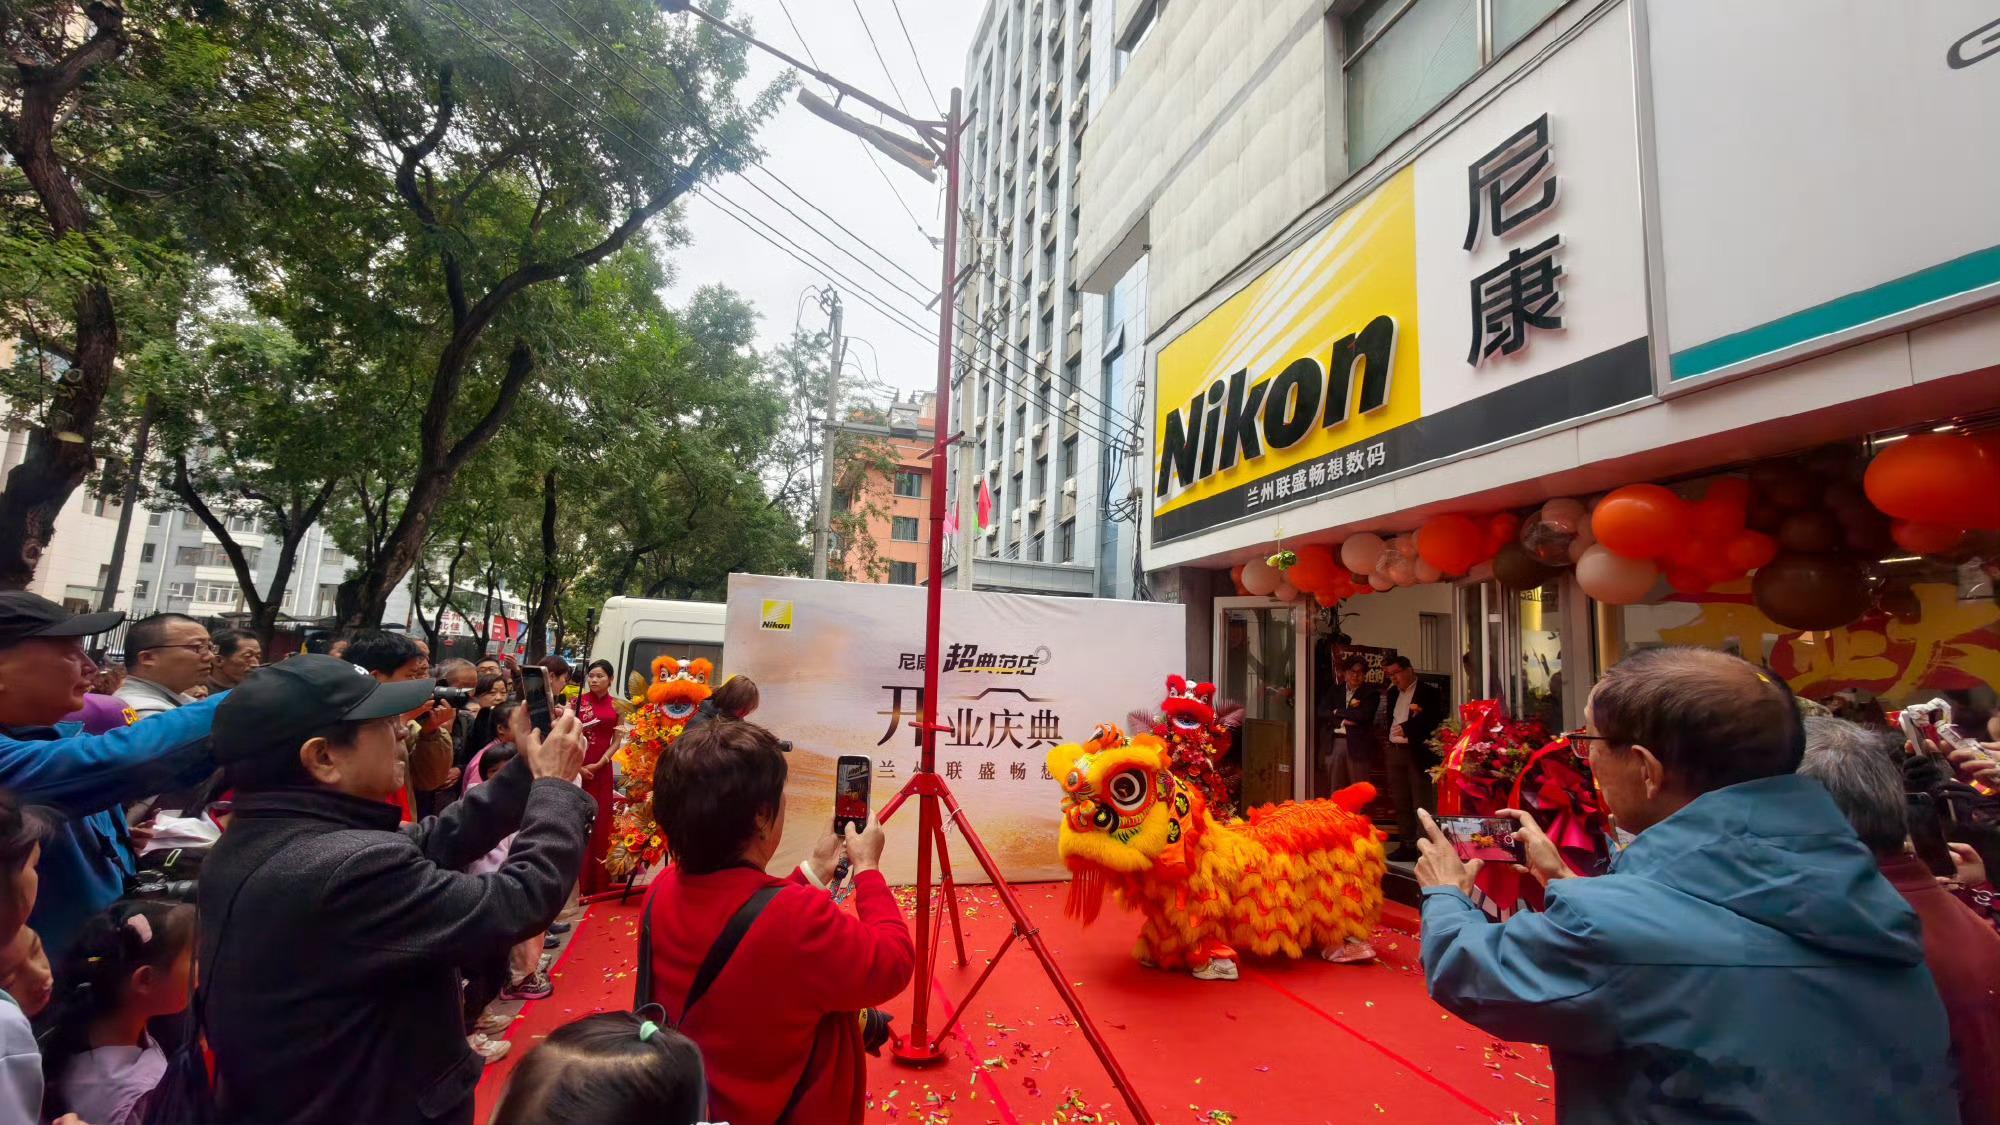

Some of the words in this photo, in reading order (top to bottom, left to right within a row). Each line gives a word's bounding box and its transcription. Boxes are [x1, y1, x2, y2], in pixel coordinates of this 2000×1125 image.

[1463, 112, 1561, 367] 尼康
[1157, 315, 1397, 498] Nikon
[1247, 442, 1386, 508] 兰州联盛畅想数码
[762, 621, 790, 629] Nikon
[877, 686, 1063, 750] 开业庆典
